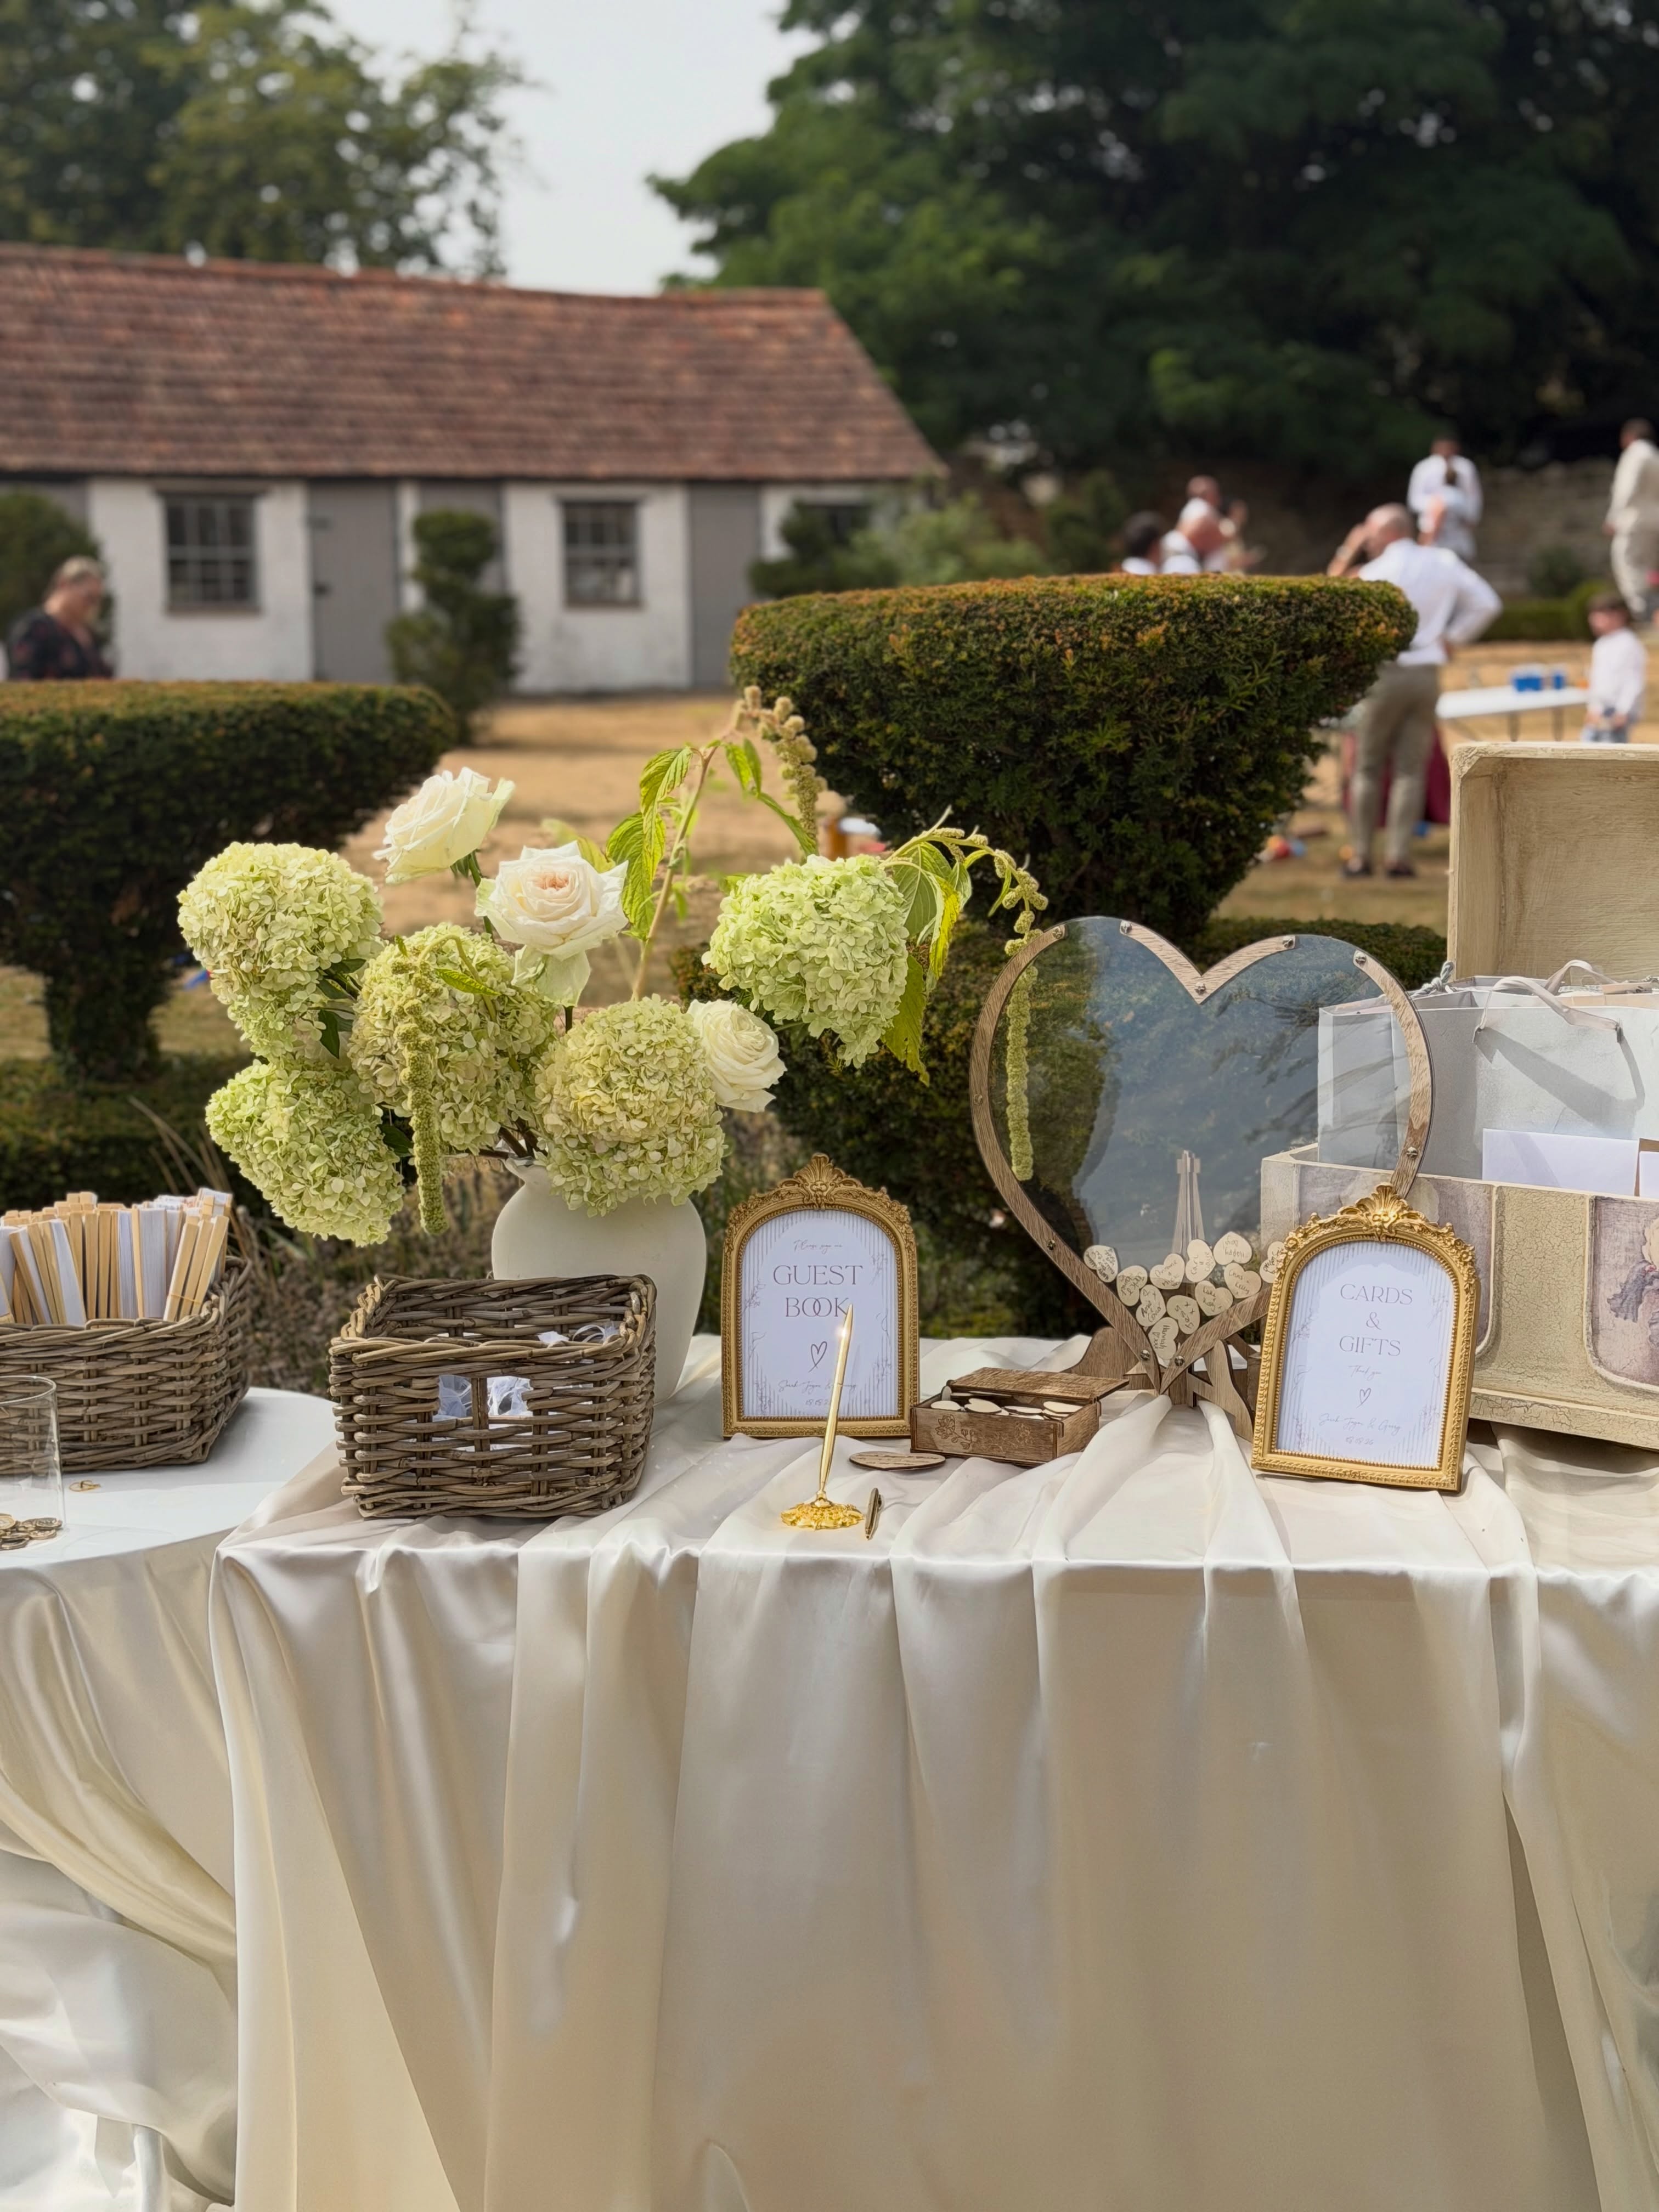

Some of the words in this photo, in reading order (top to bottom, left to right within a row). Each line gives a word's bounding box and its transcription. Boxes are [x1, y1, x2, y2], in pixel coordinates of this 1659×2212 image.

[774, 1265, 863, 1285] GUEST
[1340, 1283, 1413, 1305] CARDS
[786, 1297, 850, 1317] BOOK
[1365, 1312, 1382, 1330] &
[1339, 1335, 1401, 1357] GIFTS
